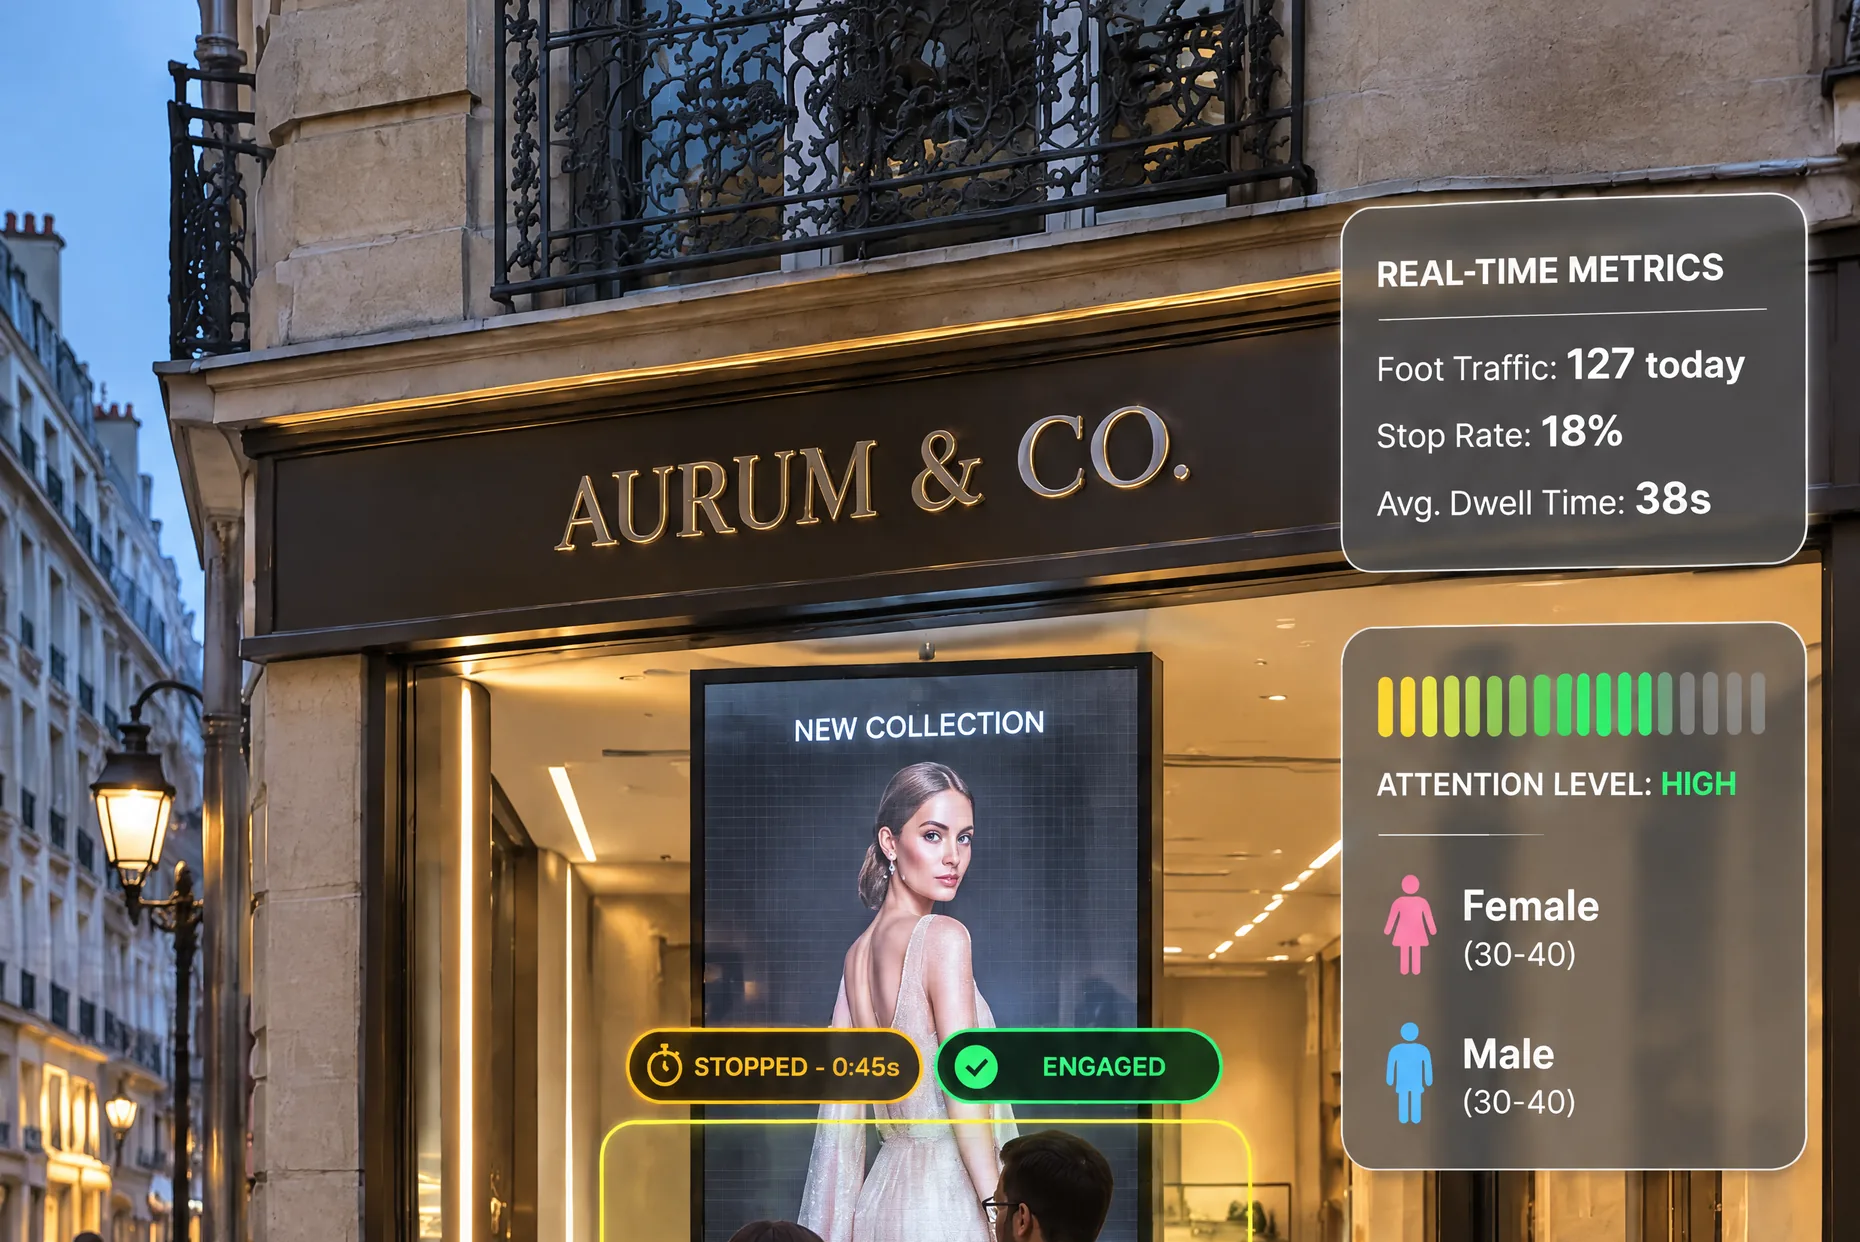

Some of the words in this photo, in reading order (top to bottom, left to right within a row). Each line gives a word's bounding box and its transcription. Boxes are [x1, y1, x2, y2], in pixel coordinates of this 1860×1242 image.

[554, 439, 878, 551] AURUM
[911, 429, 985, 513] &
[1016, 404, 1191, 498] CO.
[796, 717, 857, 741] NEW
[866, 711, 1043, 739] COLLECTION
